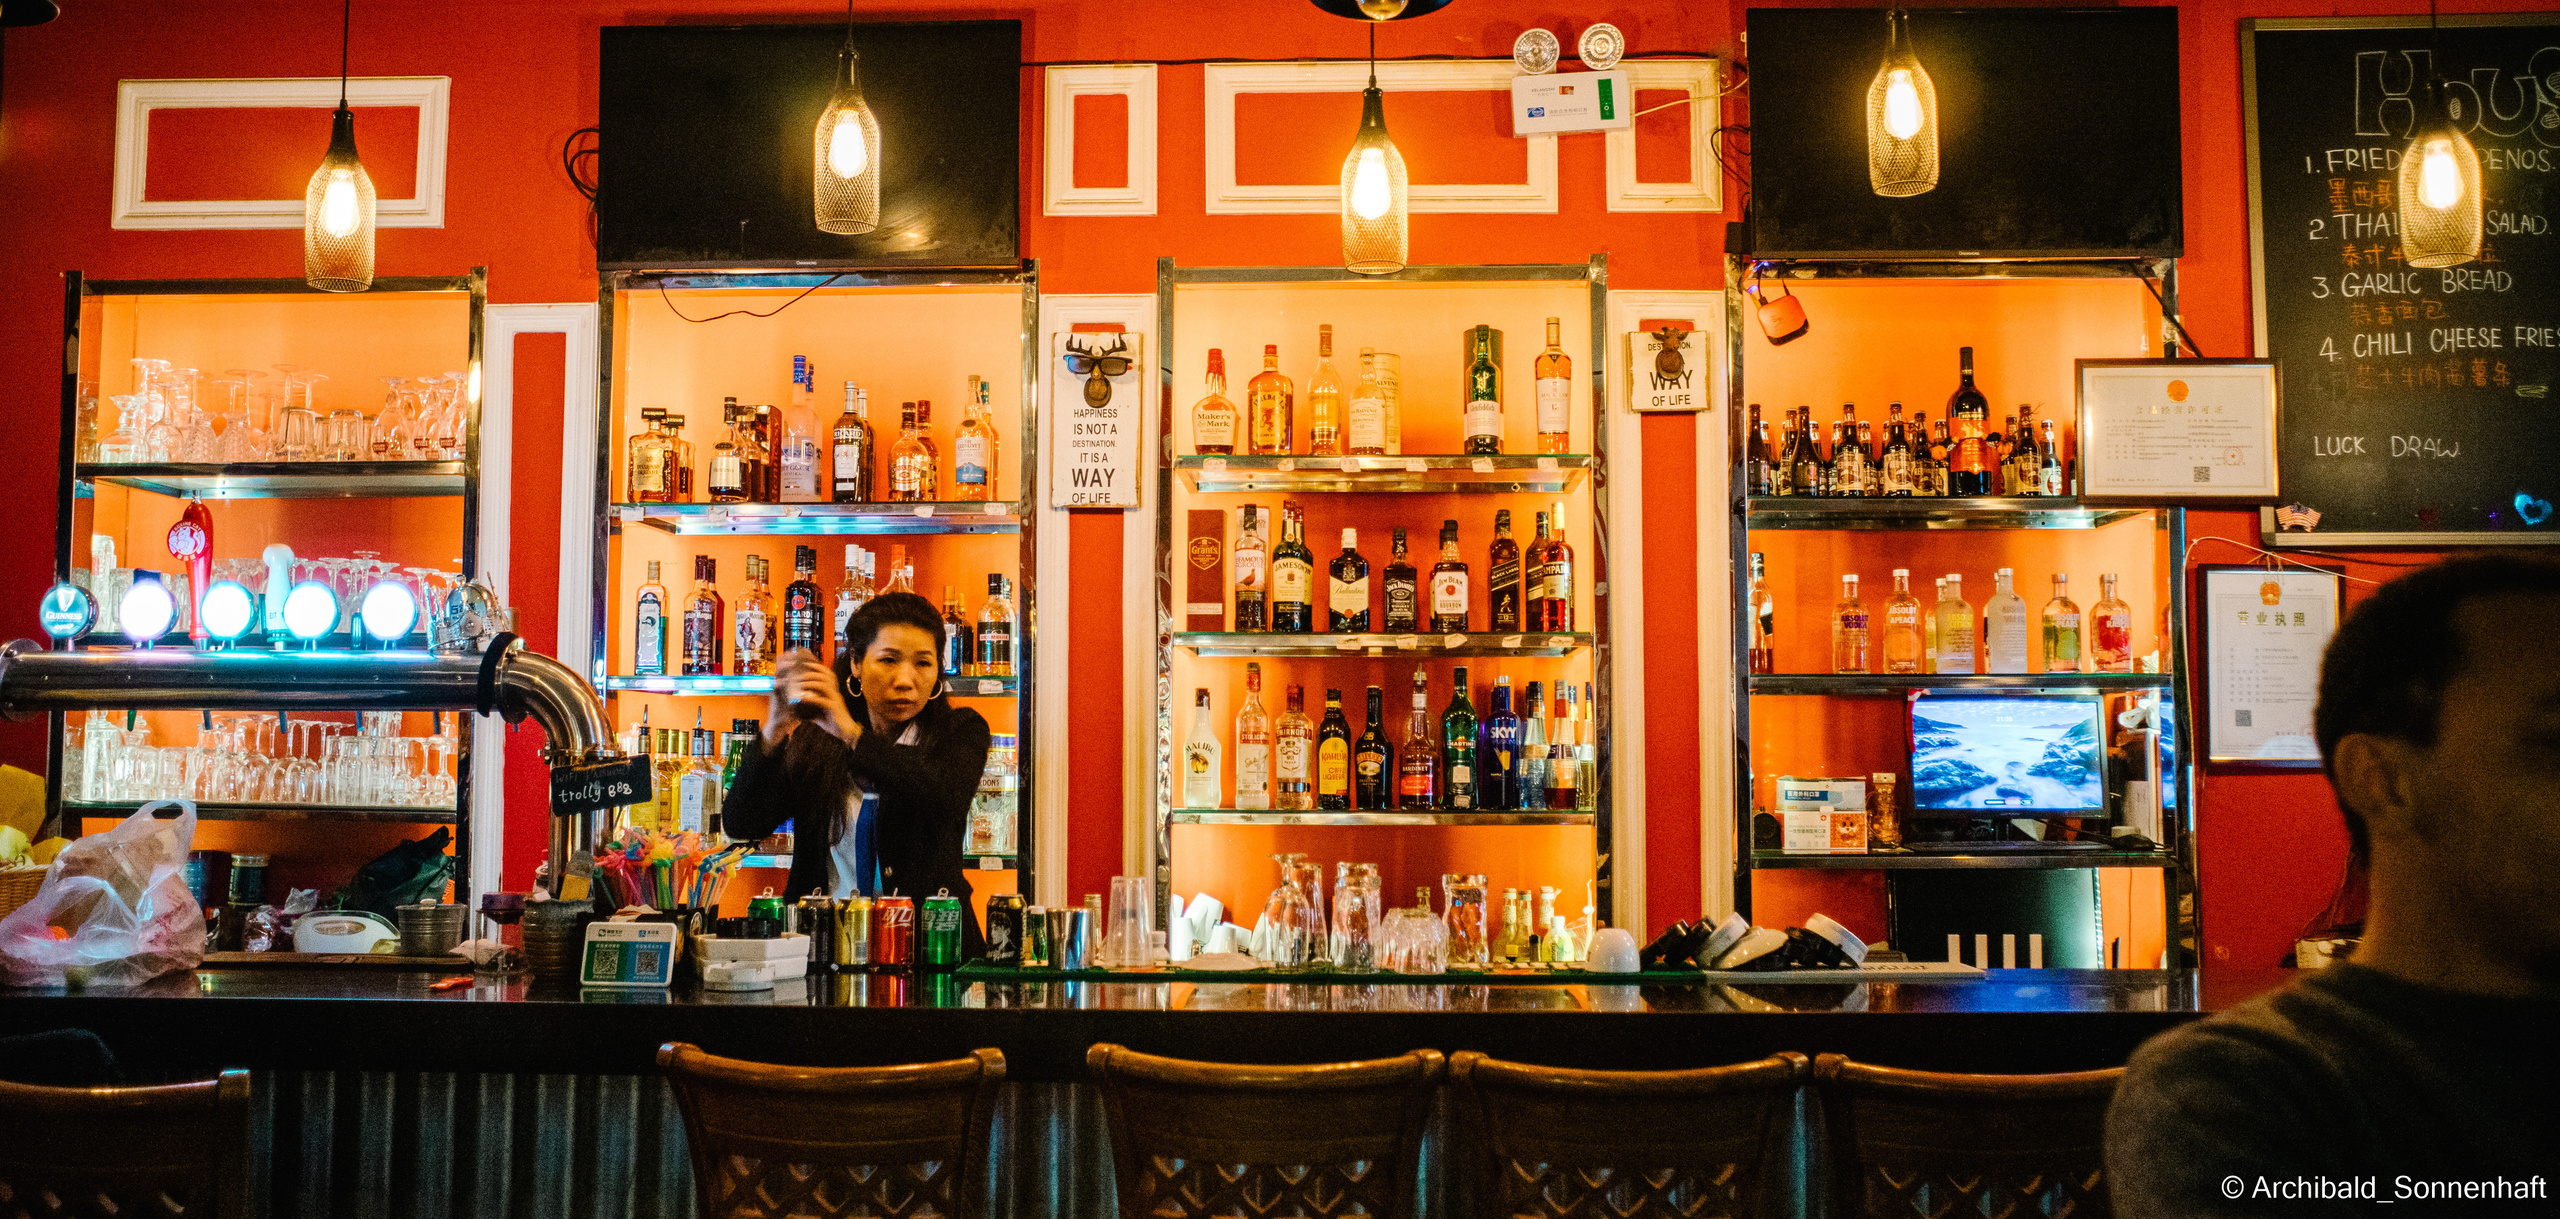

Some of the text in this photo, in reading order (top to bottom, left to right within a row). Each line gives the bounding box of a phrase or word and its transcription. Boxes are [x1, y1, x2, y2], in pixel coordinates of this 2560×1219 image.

[2325, 148, 2401, 172] FRIED
[2482, 149, 2556, 172] PENOS.
[2309, 210, 2552, 240] 2. THAI SALAD.
[2312, 270, 2513, 298] 3. GARLIC BREAD
[1648, 342, 1693, 351] DESTION.
[2320, 337, 2342, 362] 4.
[2353, 332, 2411, 358] CHILI
[2429, 328, 2503, 353] CHEESE
[1650, 370, 1693, 391] WAY
[1652, 394, 1691, 406] OF LIFE
[1074, 409, 1118, 418] HAPPINESS
[1074, 424, 1117, 434] IS NOT A
[2314, 436, 2366, 457] LUCK
[1080, 453, 1108, 463] IT IS A
[1072, 468, 1115, 488] WAY
[1072, 493, 1111, 504] OF LIFE
[1192, 546, 1218, 554] Grant's
[1448, 576, 1463, 586] BEAM
[1889, 606, 1917, 614] ABSOLUT
[2237, 611, 2305, 626] 营业执照
[1490, 727, 1517, 738] SKYY
[1186, 741, 1215, 754] MALIBU
